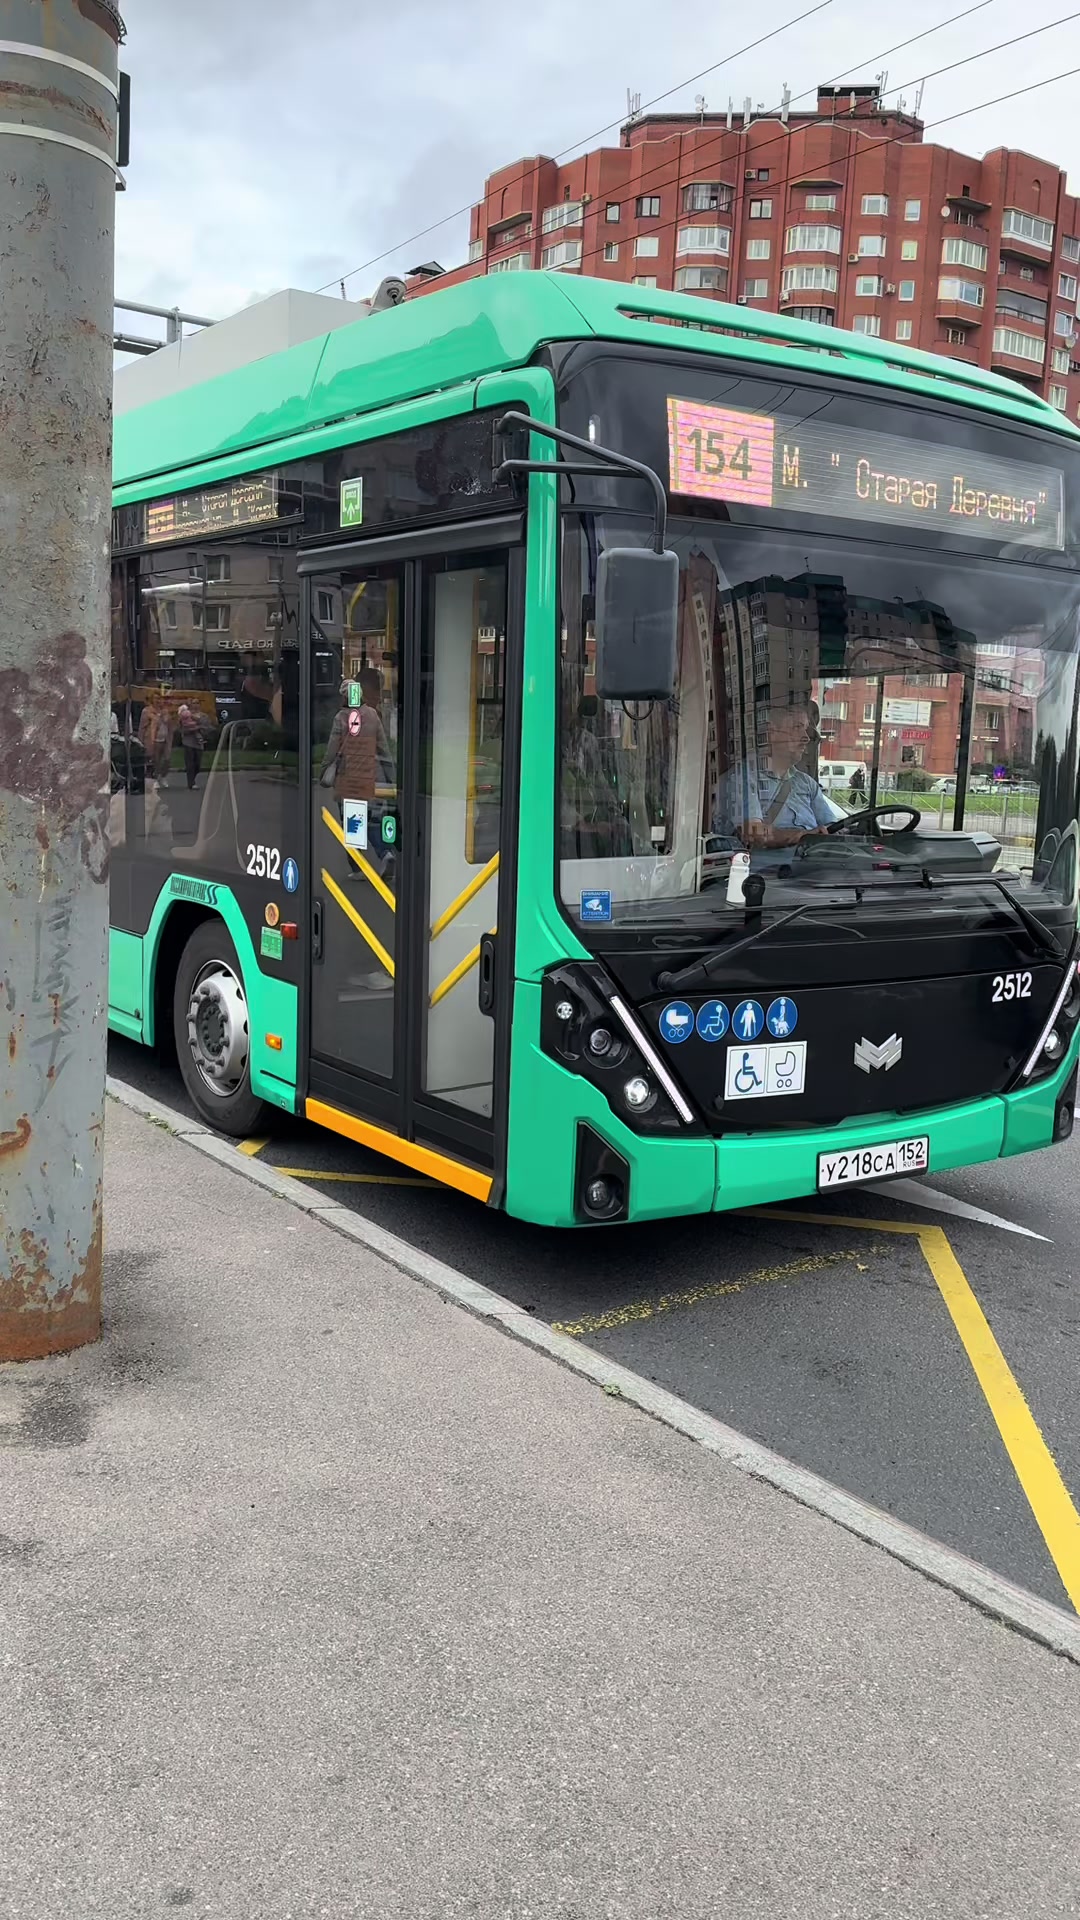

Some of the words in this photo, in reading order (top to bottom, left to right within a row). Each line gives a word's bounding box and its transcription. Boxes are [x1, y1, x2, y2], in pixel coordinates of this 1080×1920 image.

[687, 428, 752, 480] 154
[246, 843, 281, 881] 2512
[991, 971, 1033, 1003] 2512
[898, 1141, 924, 1162] 152
[902, 1159, 916, 1168] RUS
